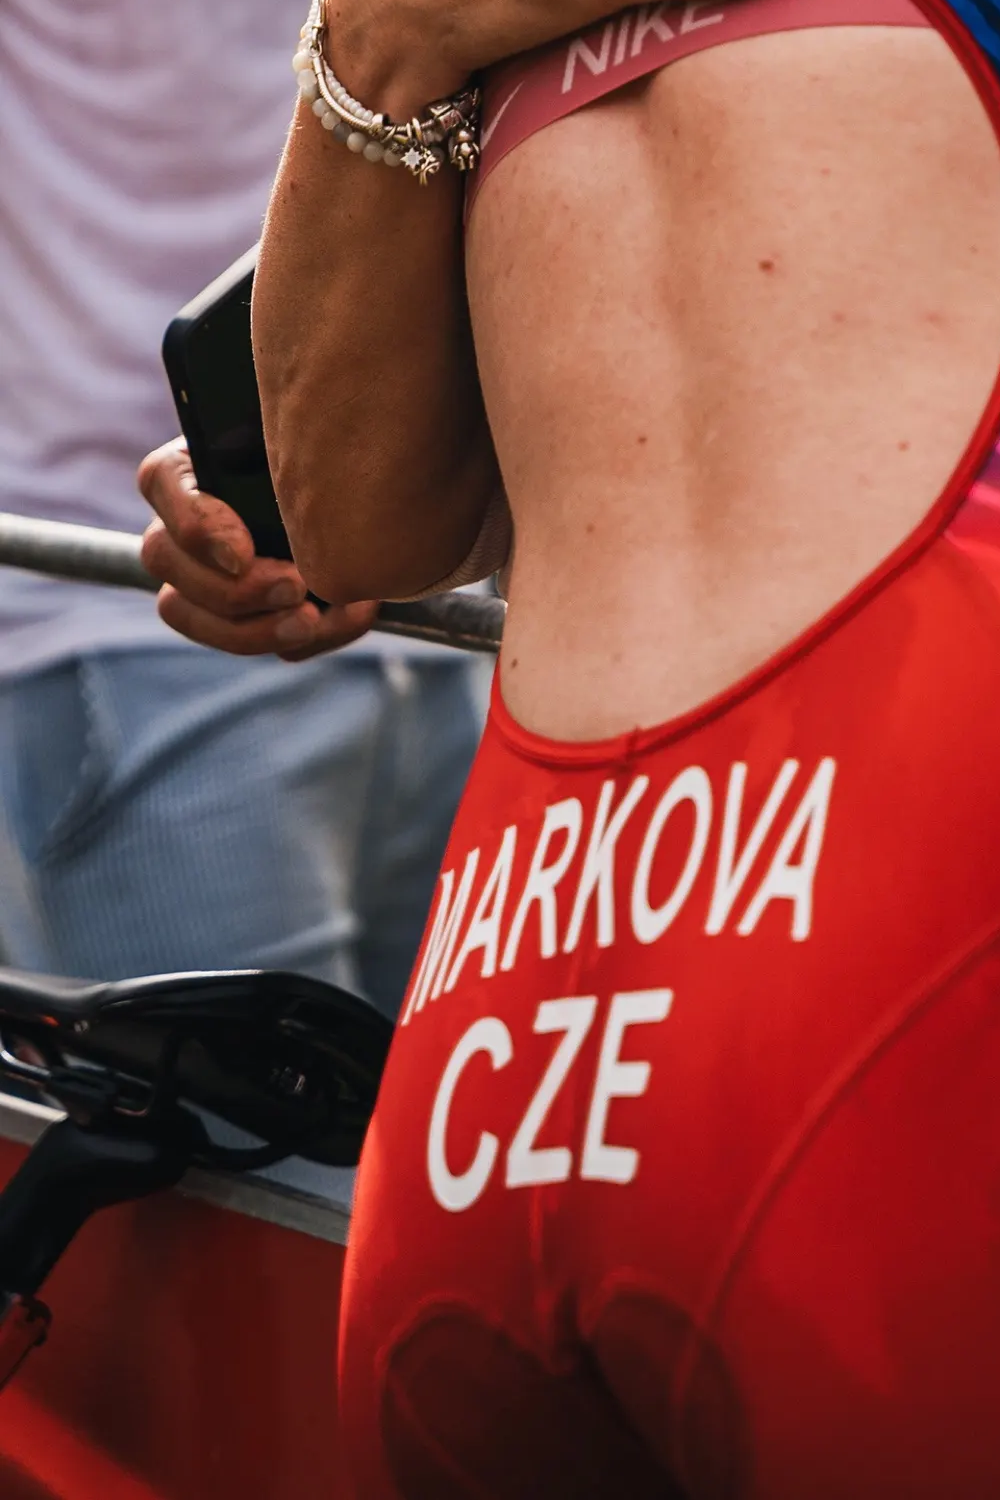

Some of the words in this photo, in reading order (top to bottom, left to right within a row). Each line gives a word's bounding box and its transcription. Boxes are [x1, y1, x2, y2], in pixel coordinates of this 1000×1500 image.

[560, 0, 725, 94] NIKE
[401, 756, 836, 1027] MARKOVA
[427, 987, 674, 1213] CZE
